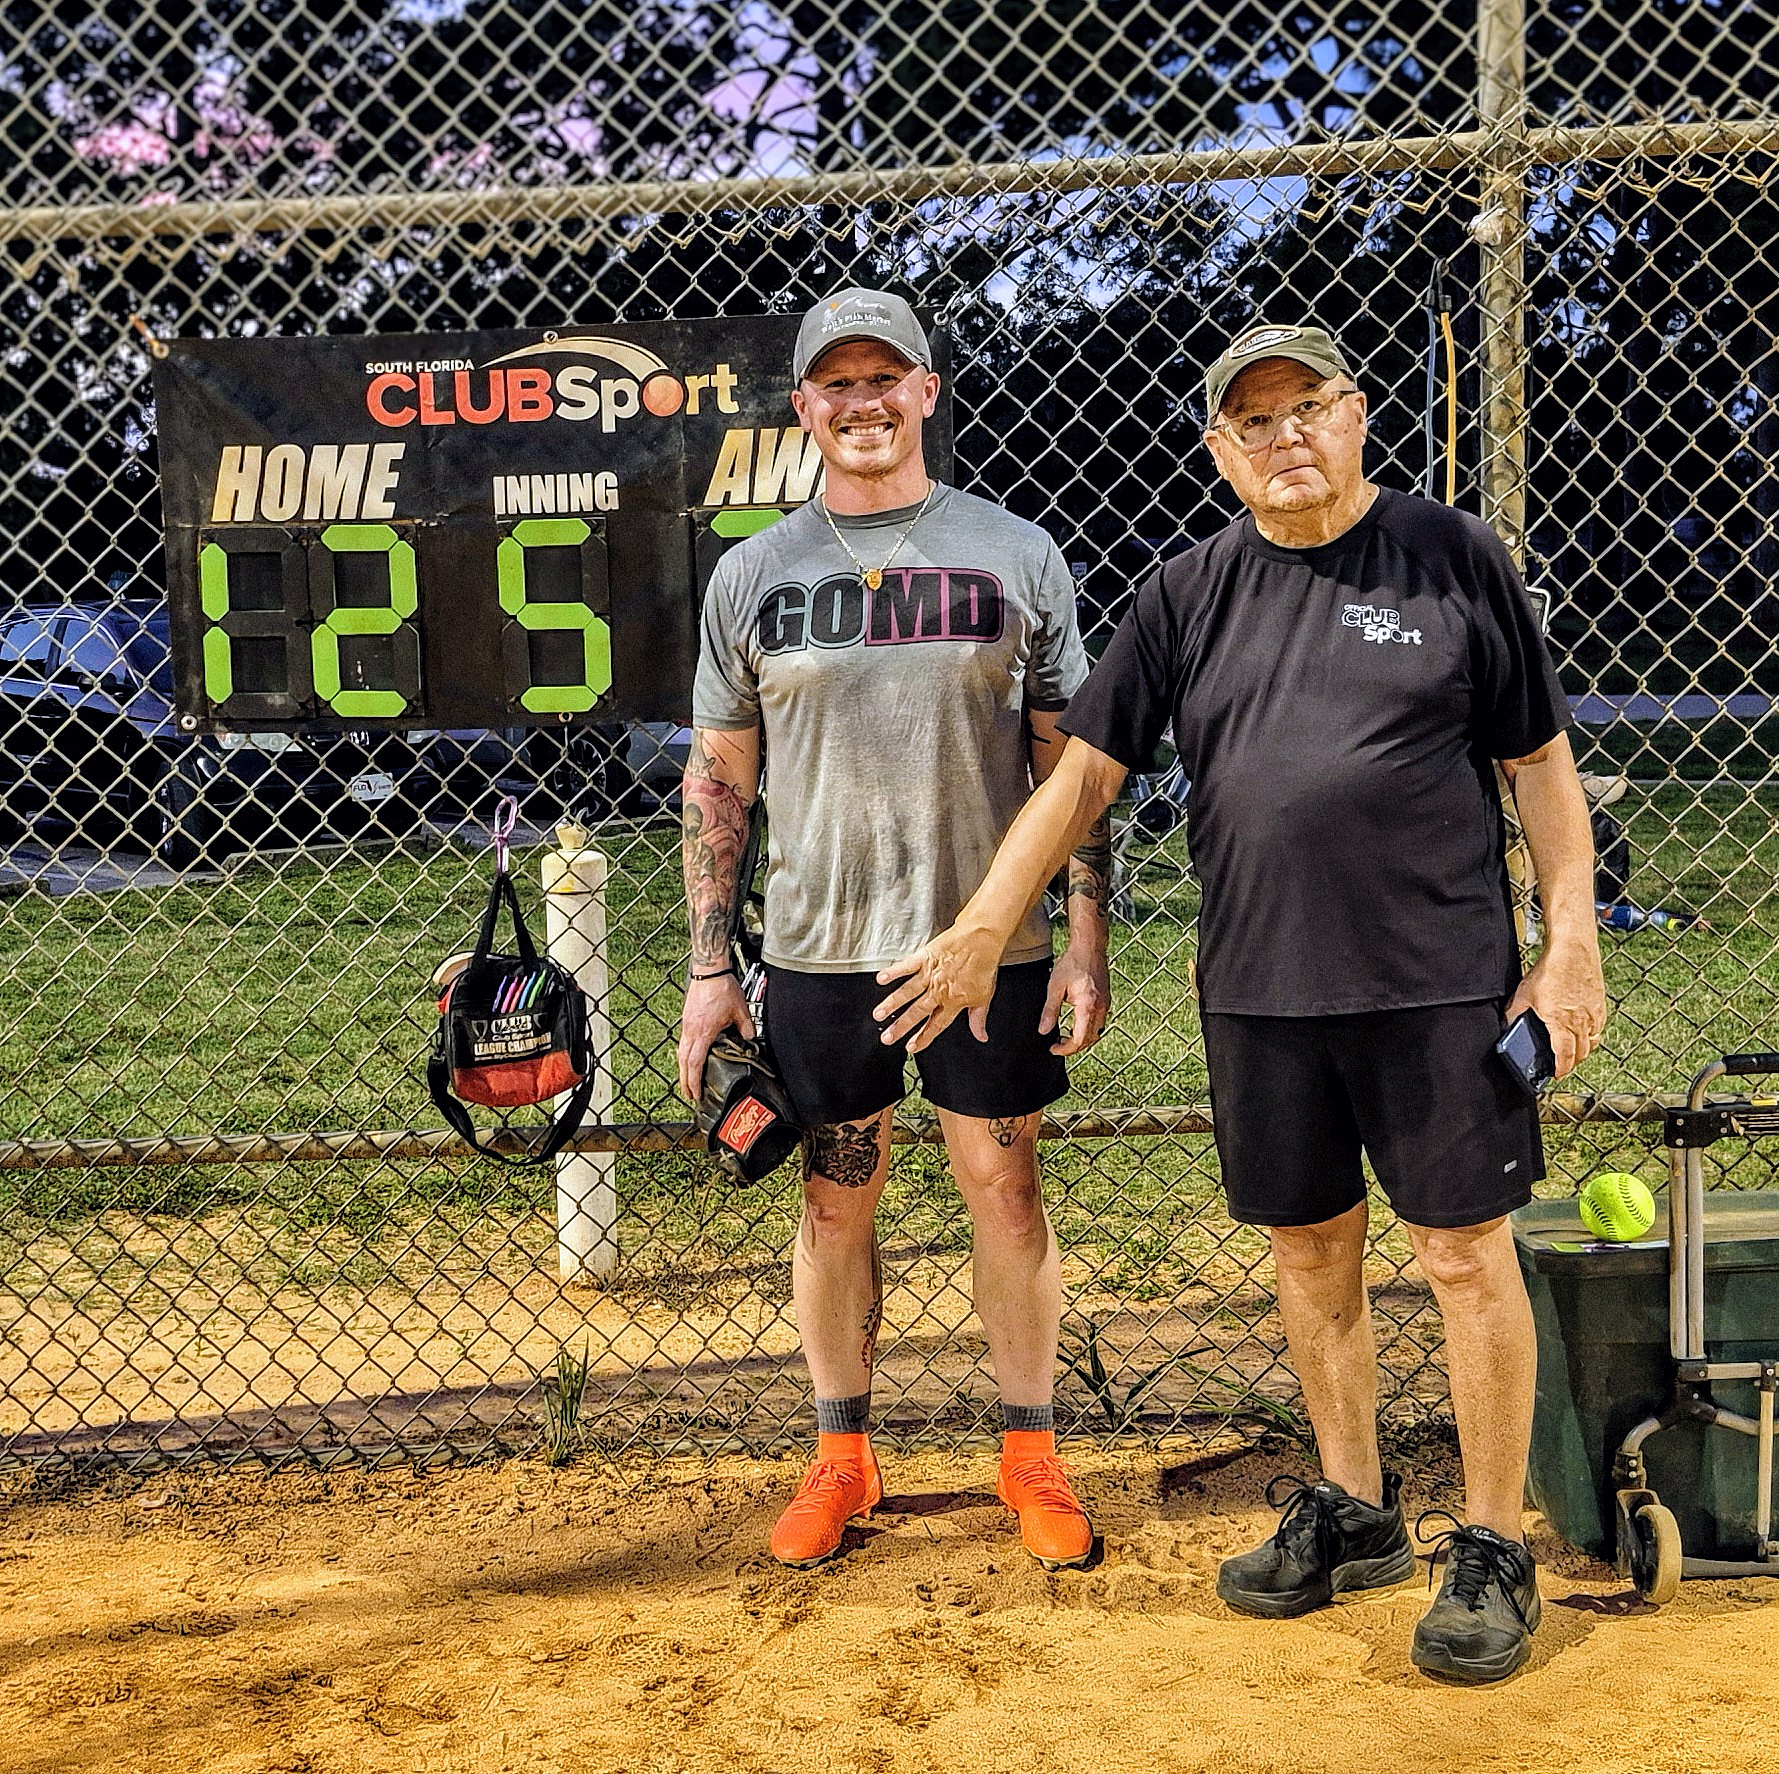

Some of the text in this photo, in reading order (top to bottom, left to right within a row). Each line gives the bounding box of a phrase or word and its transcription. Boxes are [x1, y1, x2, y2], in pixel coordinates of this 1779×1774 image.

[365, 358, 475, 374] SOUTH FLORIDA
[366, 363, 740, 434] CLUBSport
[211, 443, 406, 522] HOME
[493, 471, 619, 515] INNING
[702, 426, 827, 506] AW
[497, 518, 612, 713] 5
[755, 567, 1005, 657] GOMD
[1341, 608, 1401, 628] CLUB
[1363, 625, 1423, 645] Sport
[474, 1042, 507, 1056] LEAGUE
